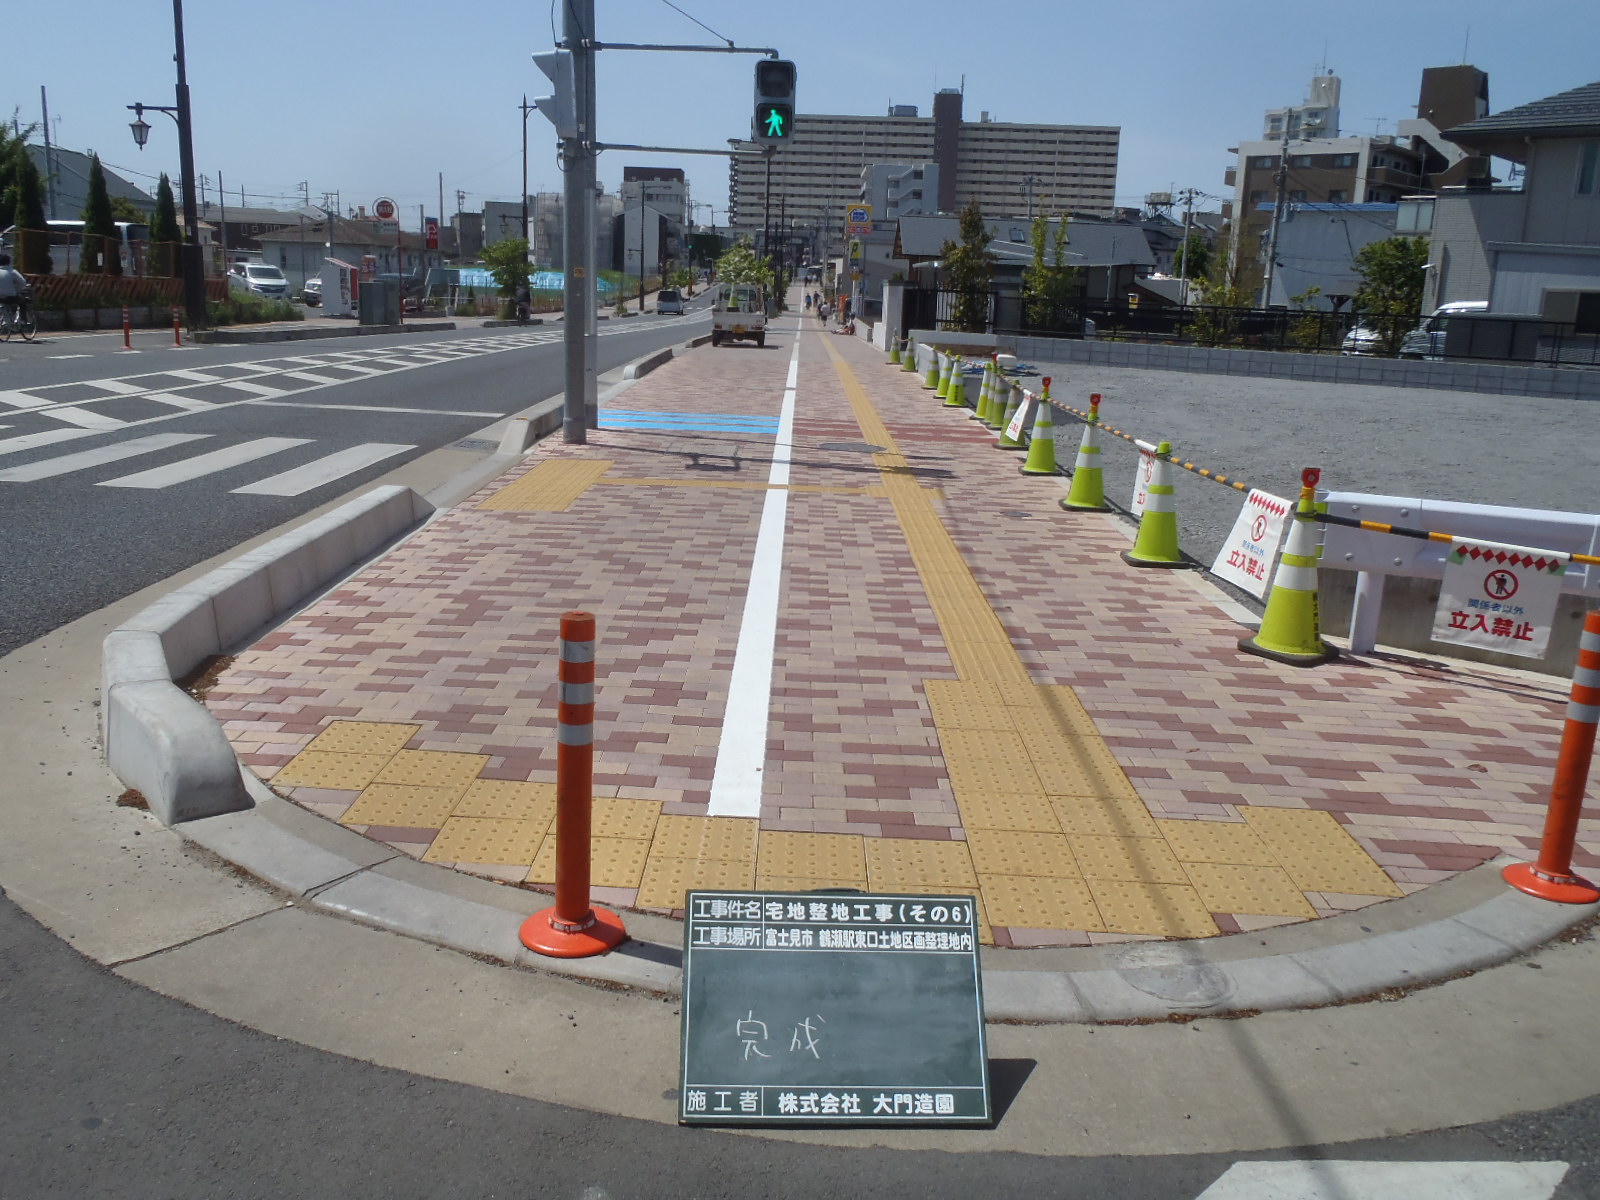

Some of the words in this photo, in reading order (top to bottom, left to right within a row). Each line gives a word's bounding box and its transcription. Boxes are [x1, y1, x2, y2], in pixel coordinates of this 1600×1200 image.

[1227, 550, 1264, 581] 立入禁止
[1467, 598, 1524, 615] 関係者以外
[1448, 611, 1534, 641] 立入禁止
[694, 900, 761, 919] 工事件名
[693, 926, 761, 946] 工事場所
[765, 928, 813, 947] 富士見市
[736, 1010, 826, 1061] 完成
[687, 1090, 759, 1112] 施工者
[778, 1092, 861, 1114] 株式会社
[873, 1093, 955, 1114] 大門造園
